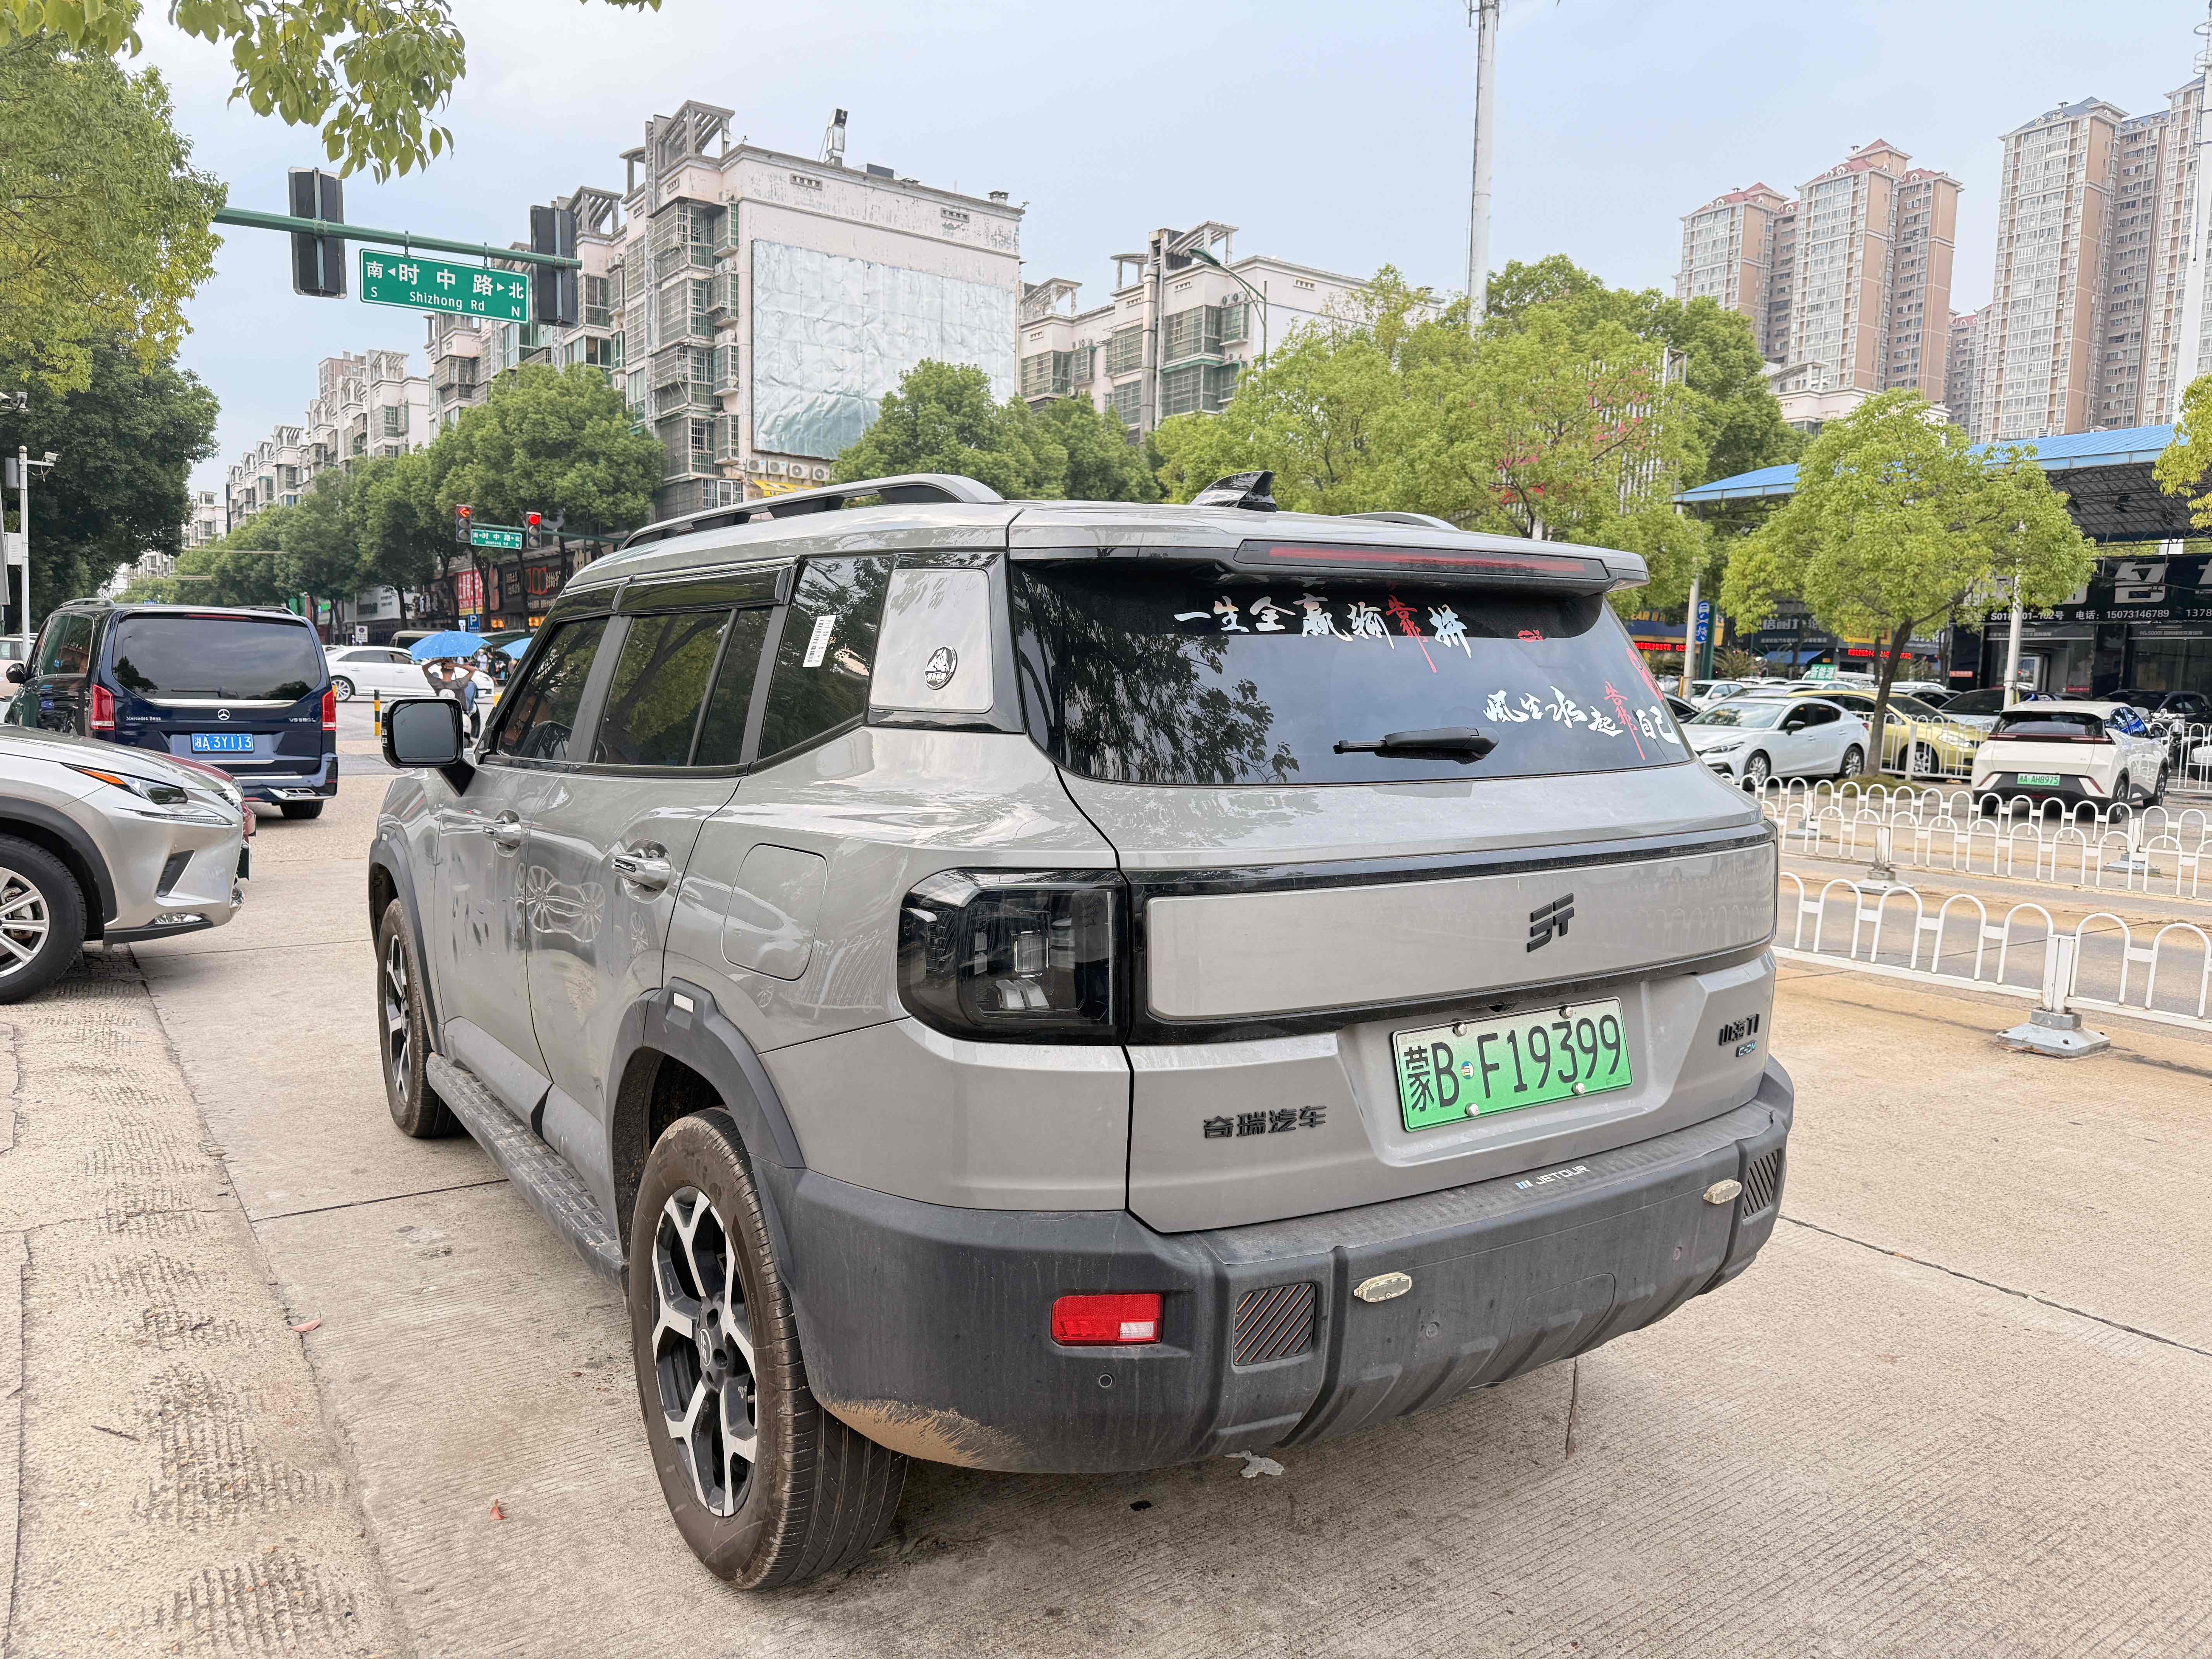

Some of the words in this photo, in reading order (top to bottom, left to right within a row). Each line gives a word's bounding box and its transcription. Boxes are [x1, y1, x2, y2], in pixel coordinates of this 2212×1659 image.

[366, 261, 383, 279] 南
[399, 264, 494, 296] 时中路
[508, 282, 524, 299] 北
[371, 287, 378, 297] S
[410, 292, 463, 310] Shizhong
[471, 300, 485, 311] Rd
[511, 306, 520, 317] N
[471, 615, 477, 626] P
[2106, 609, 2170, 619] 15073146789
[1810, 666, 1835, 680] 新能源
[1203, 1105, 1328, 1139] 奇瑞汽车
[1535, 1165, 1590, 1185] JETOUR
